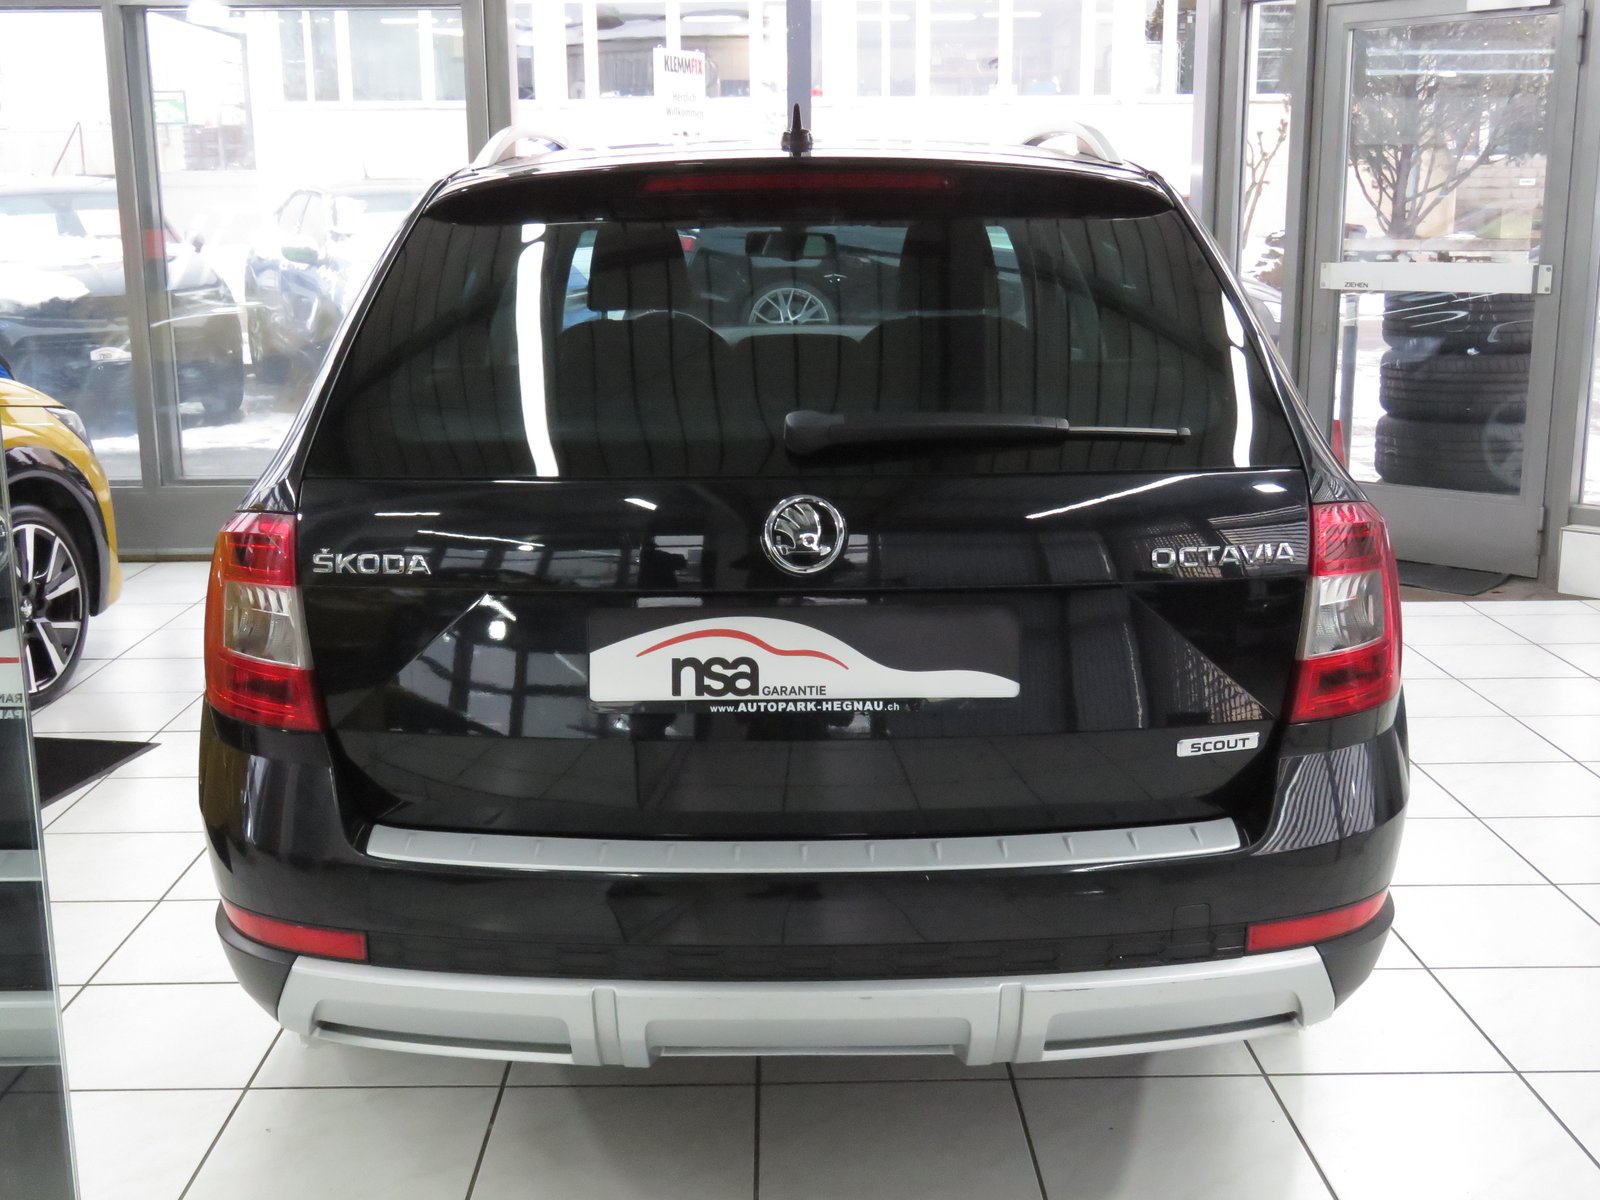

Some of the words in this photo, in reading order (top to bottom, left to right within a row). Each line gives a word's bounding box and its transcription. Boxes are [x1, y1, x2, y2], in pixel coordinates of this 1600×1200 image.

[664, 55, 703, 75] KLEMMFIX
[672, 92, 697, 102] Herzlich
[666, 107, 704, 119] Willkommen
[312, 547, 432, 575] ŠKODA
[1151, 541, 1295, 569] OCTAVIA
[671, 656, 760, 698] nsa
[762, 685, 827, 696] GARANTIE
[709, 701, 900, 713] www.AUTOPARK-HEGNAU.ch
[1190, 737, 1250, 753] SCOUT
